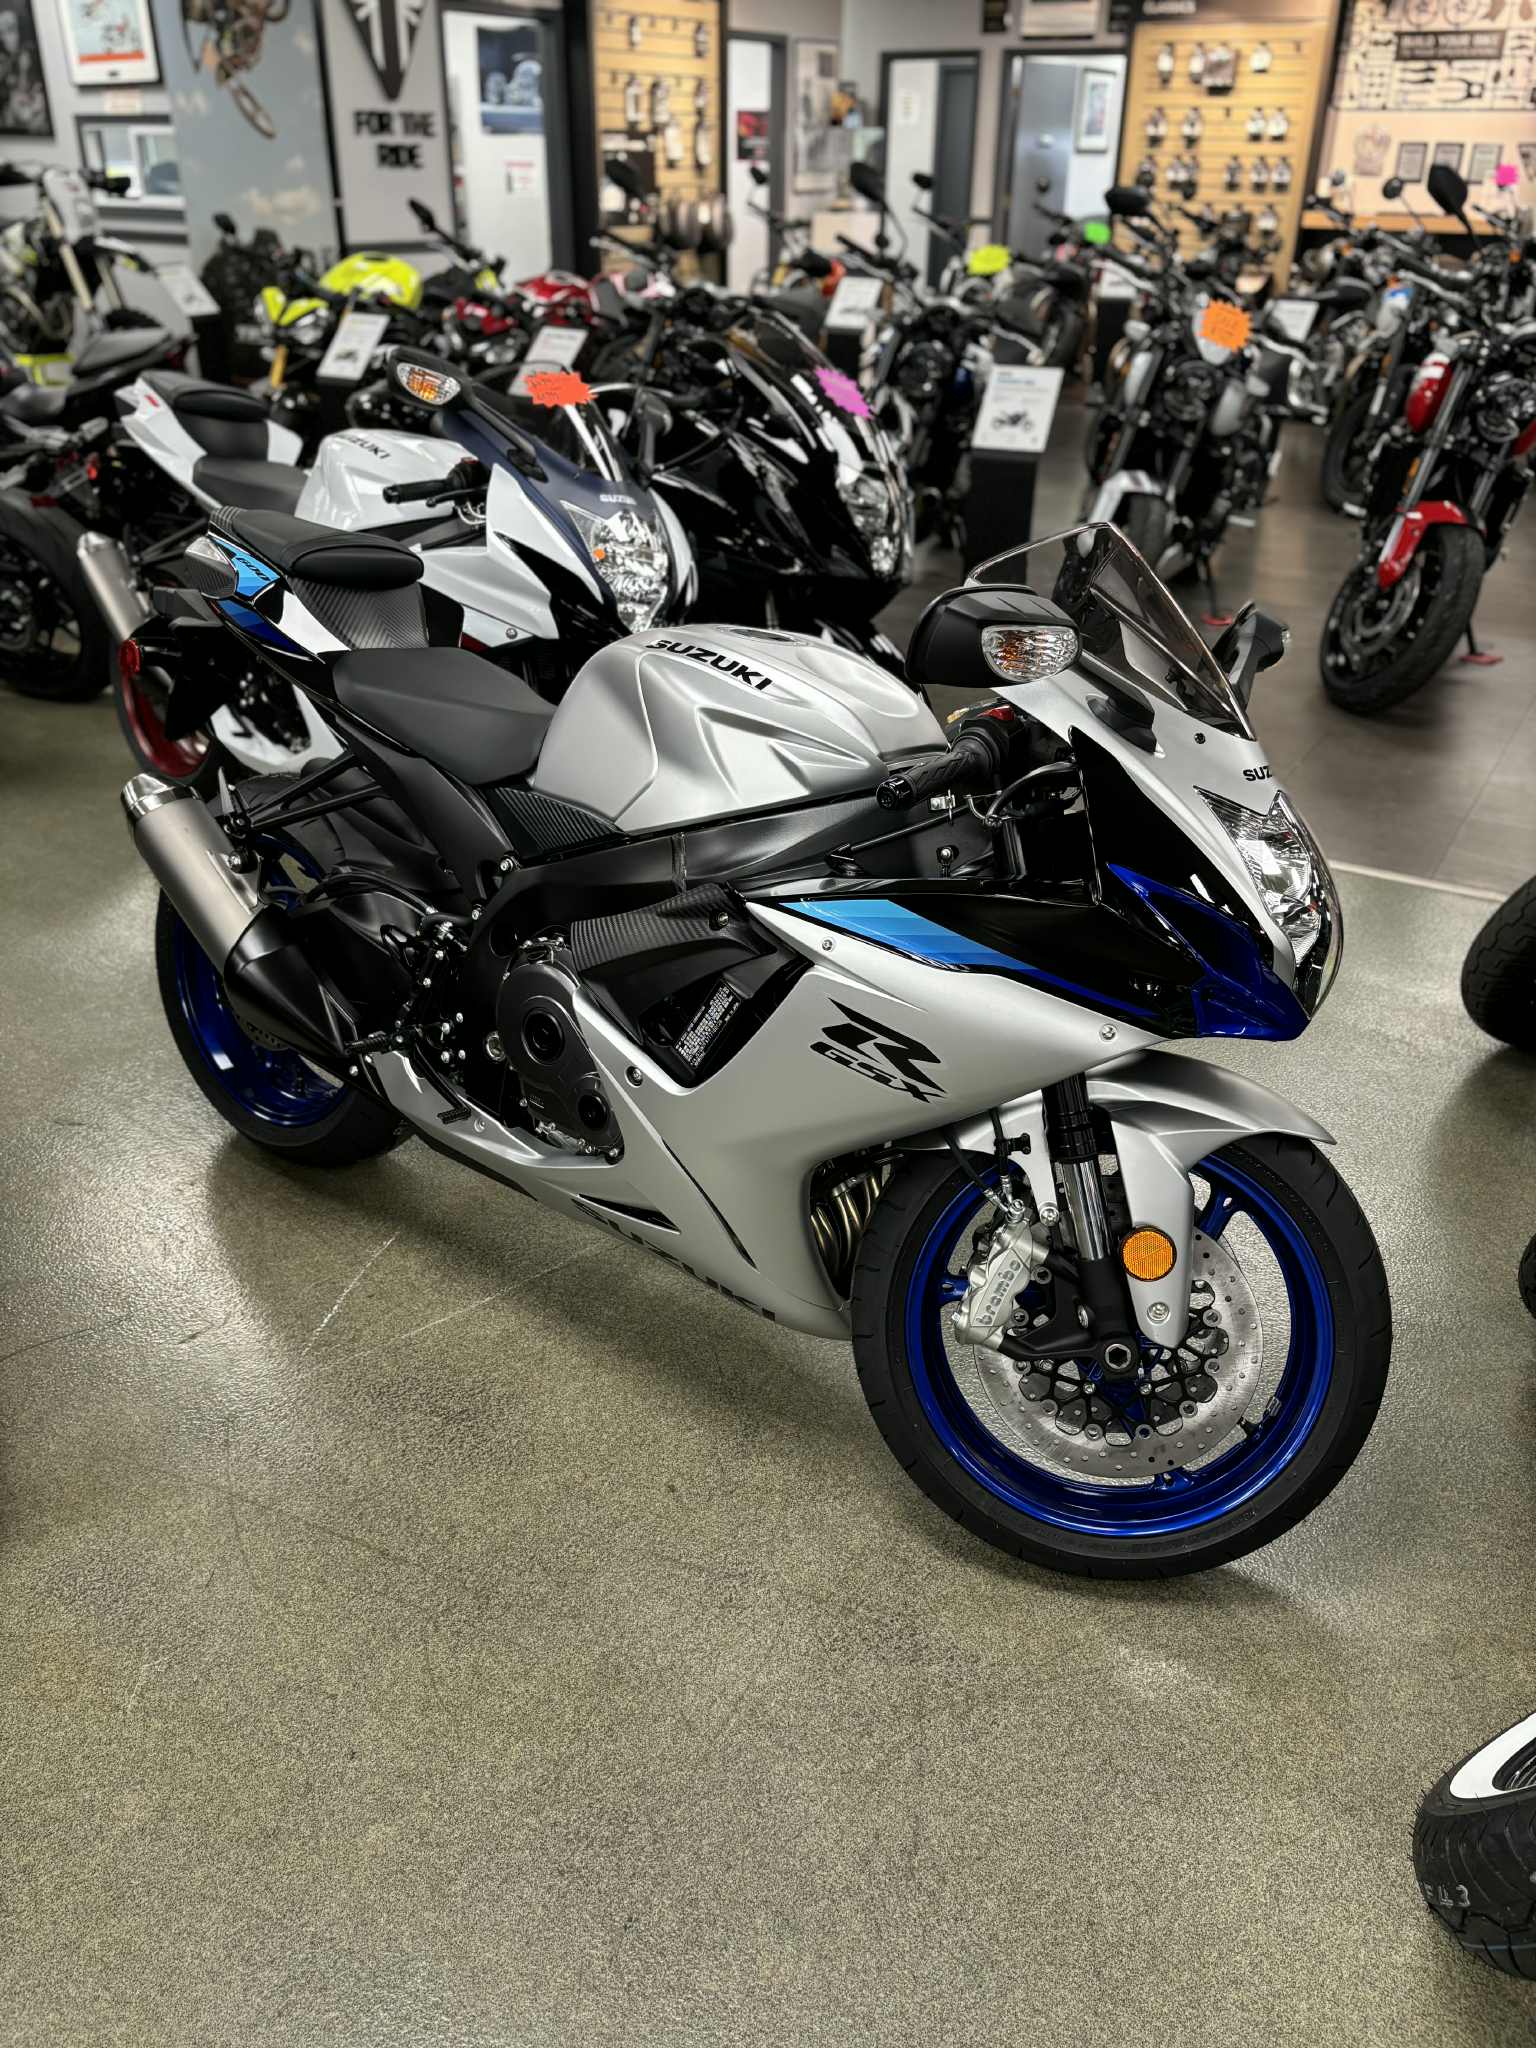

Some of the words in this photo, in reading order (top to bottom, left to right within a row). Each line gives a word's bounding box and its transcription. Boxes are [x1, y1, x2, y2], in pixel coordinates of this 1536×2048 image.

[353, 110, 393, 137] FOR
[400, 110, 436, 137] THE
[377, 142, 423, 168] RIDE
[645, 639, 773, 691] SUZUKI
[809, 1040, 949, 1104] GSX
[820, 996, 947, 1095] R
[975, 1260, 1021, 1326] brembo
